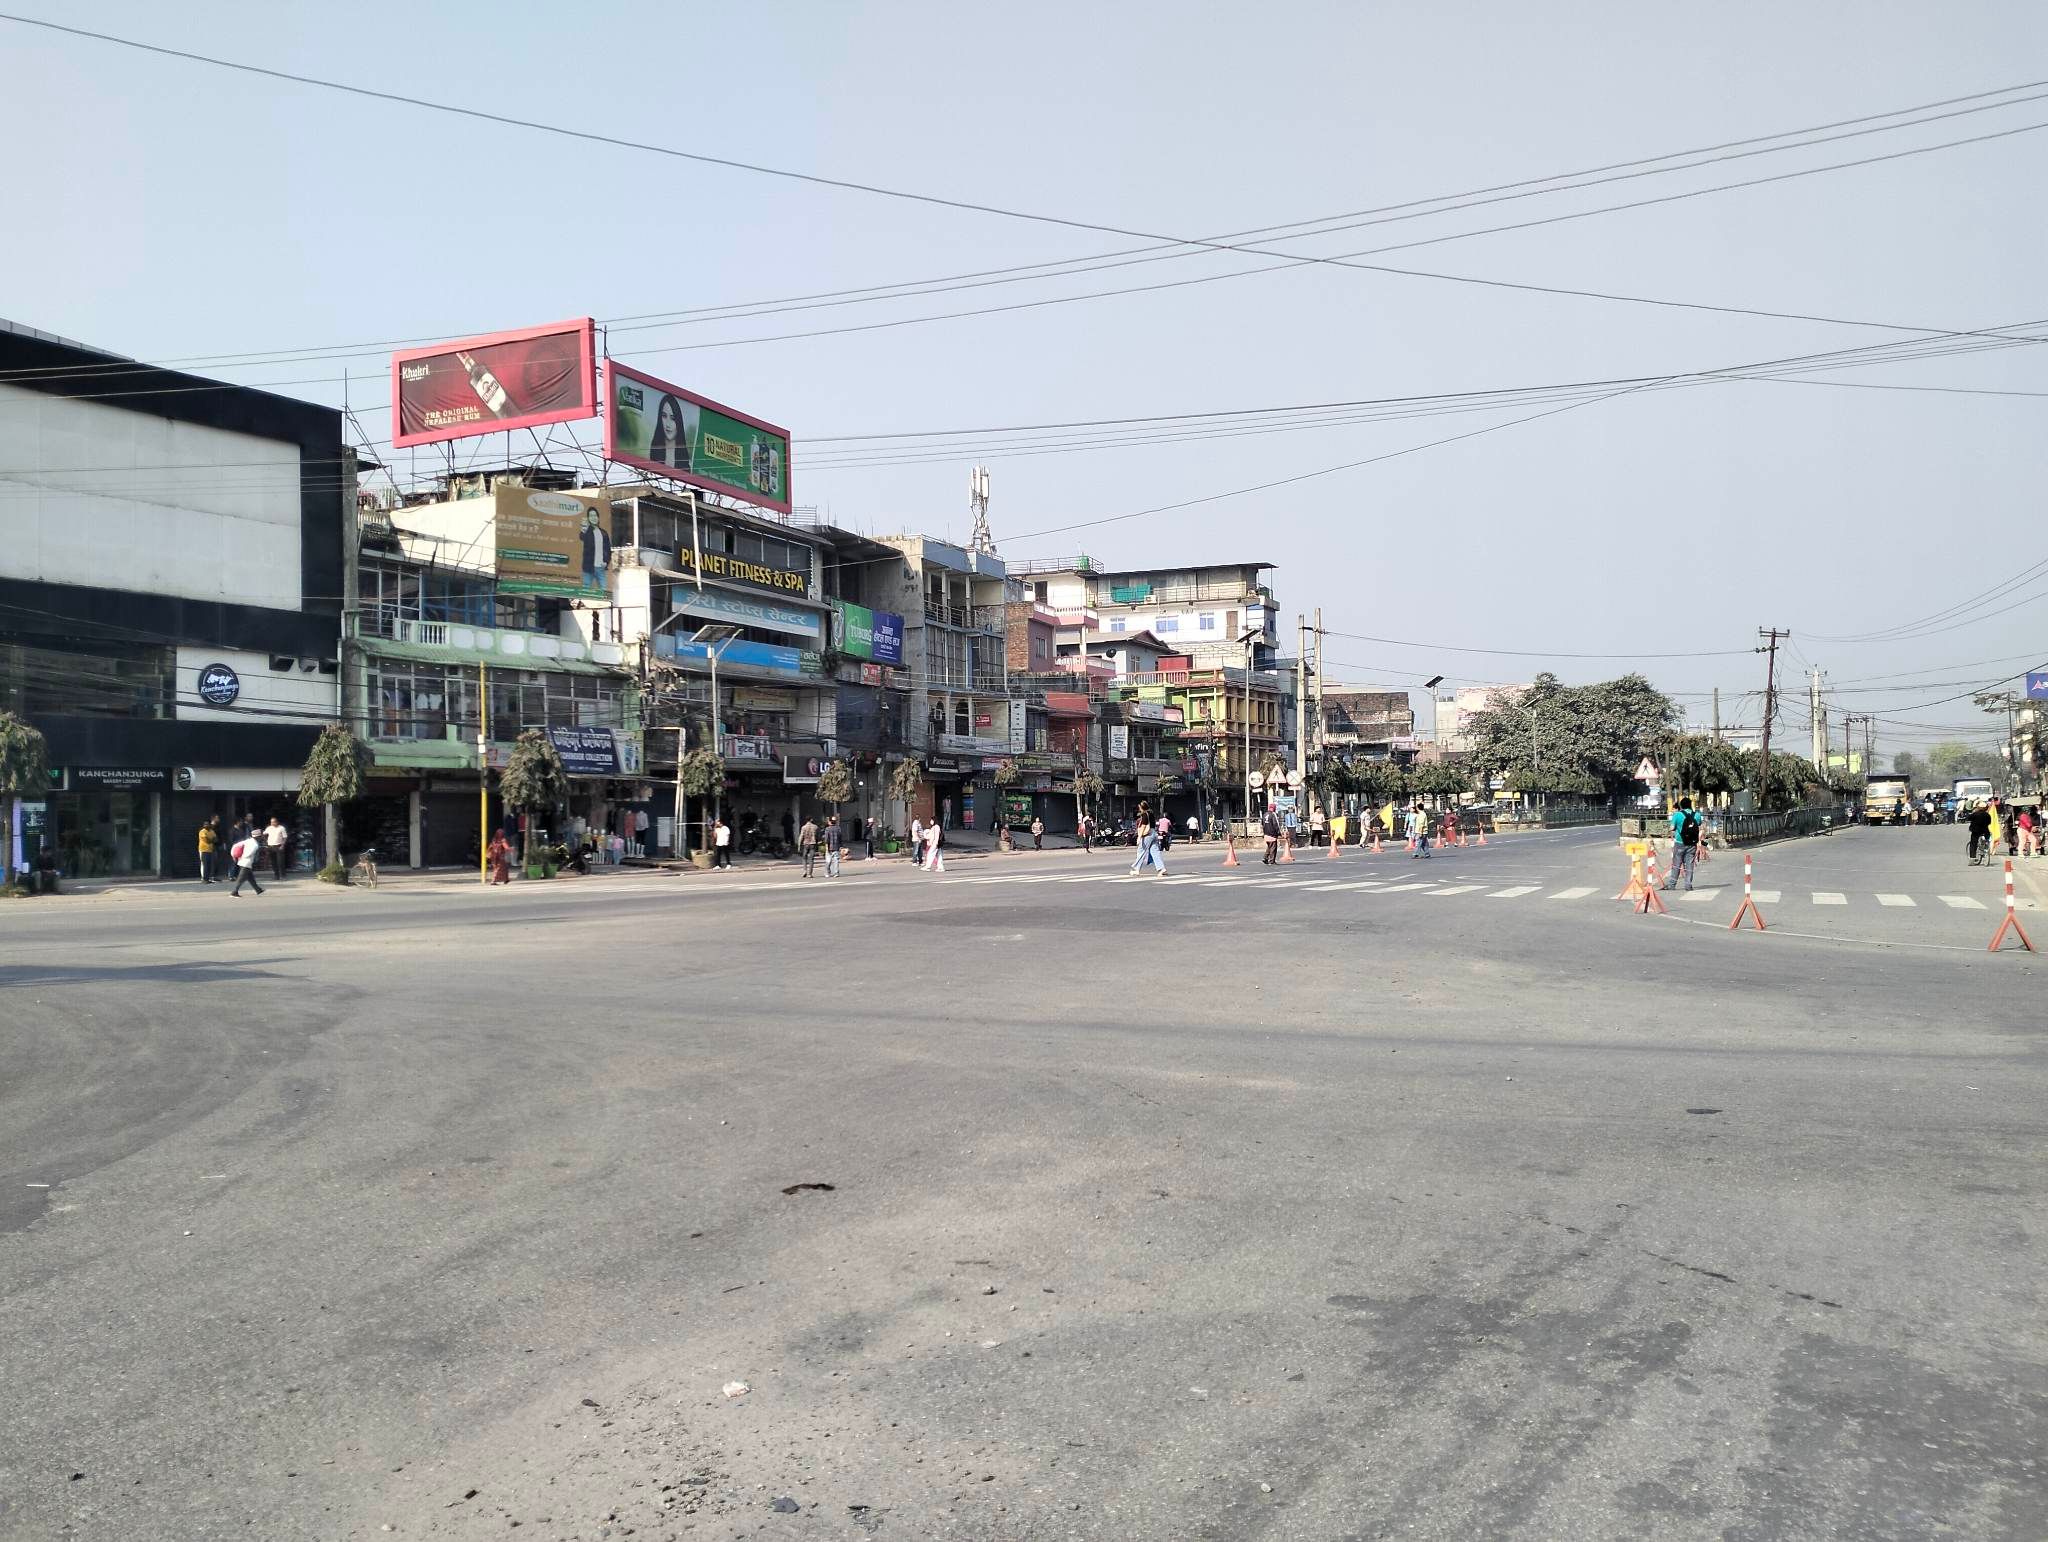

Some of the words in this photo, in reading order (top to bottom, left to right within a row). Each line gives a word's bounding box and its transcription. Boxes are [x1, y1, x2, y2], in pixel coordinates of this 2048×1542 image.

[402, 364, 429, 379] Khukri
[424, 416, 462, 426] NEPALESE
[464, 412, 480, 421] RUM
[426, 411, 441, 420] THE
[443, 405, 479, 416] ORIGINAL
[706, 437, 715, 455] 10
[716, 440, 742, 457] NATURAL
[681, 548, 727, 575] PLANET
[730, 559, 773, 585] FITNESS
[773, 570, 784, 588] &
[785, 572, 805, 592] SPA
[850, 624, 872, 642] TUBORG
[932, 756, 956, 766] Panasonic
[78, 770, 164, 778] KANCHANJUNGA
